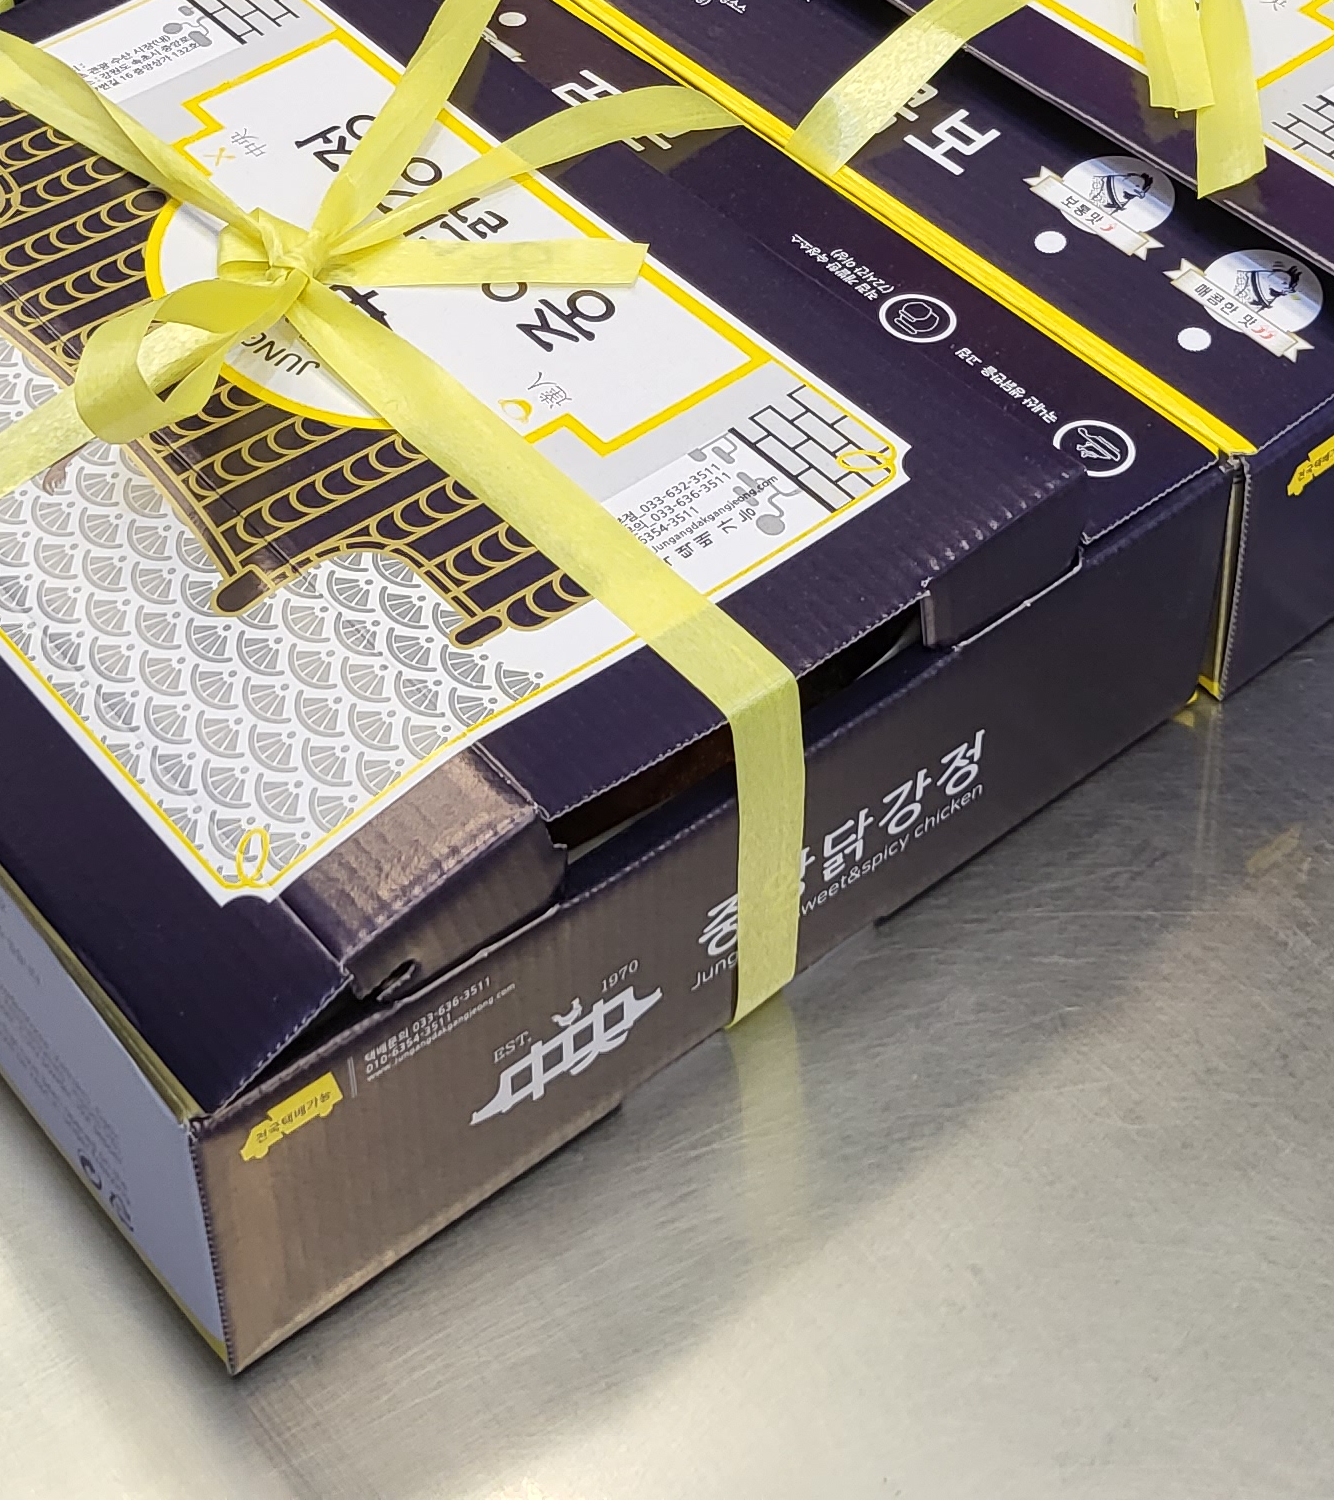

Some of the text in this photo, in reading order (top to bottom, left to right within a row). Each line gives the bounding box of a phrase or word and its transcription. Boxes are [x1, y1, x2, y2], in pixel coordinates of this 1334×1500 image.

[1020, 395, 1059, 424] 국내산
[799, 833, 910, 917] weet&spicy
[914, 782, 984, 840] chicken
[599, 959, 640, 993] 1970
[363, 975, 493, 1063] 택배문의 033-636-3511
[365, 1011, 454, 1075] 010-6354-3511
[492, 1030, 533, 1064] EST.
[255, 1090, 333, 1145] 전국택배가능
